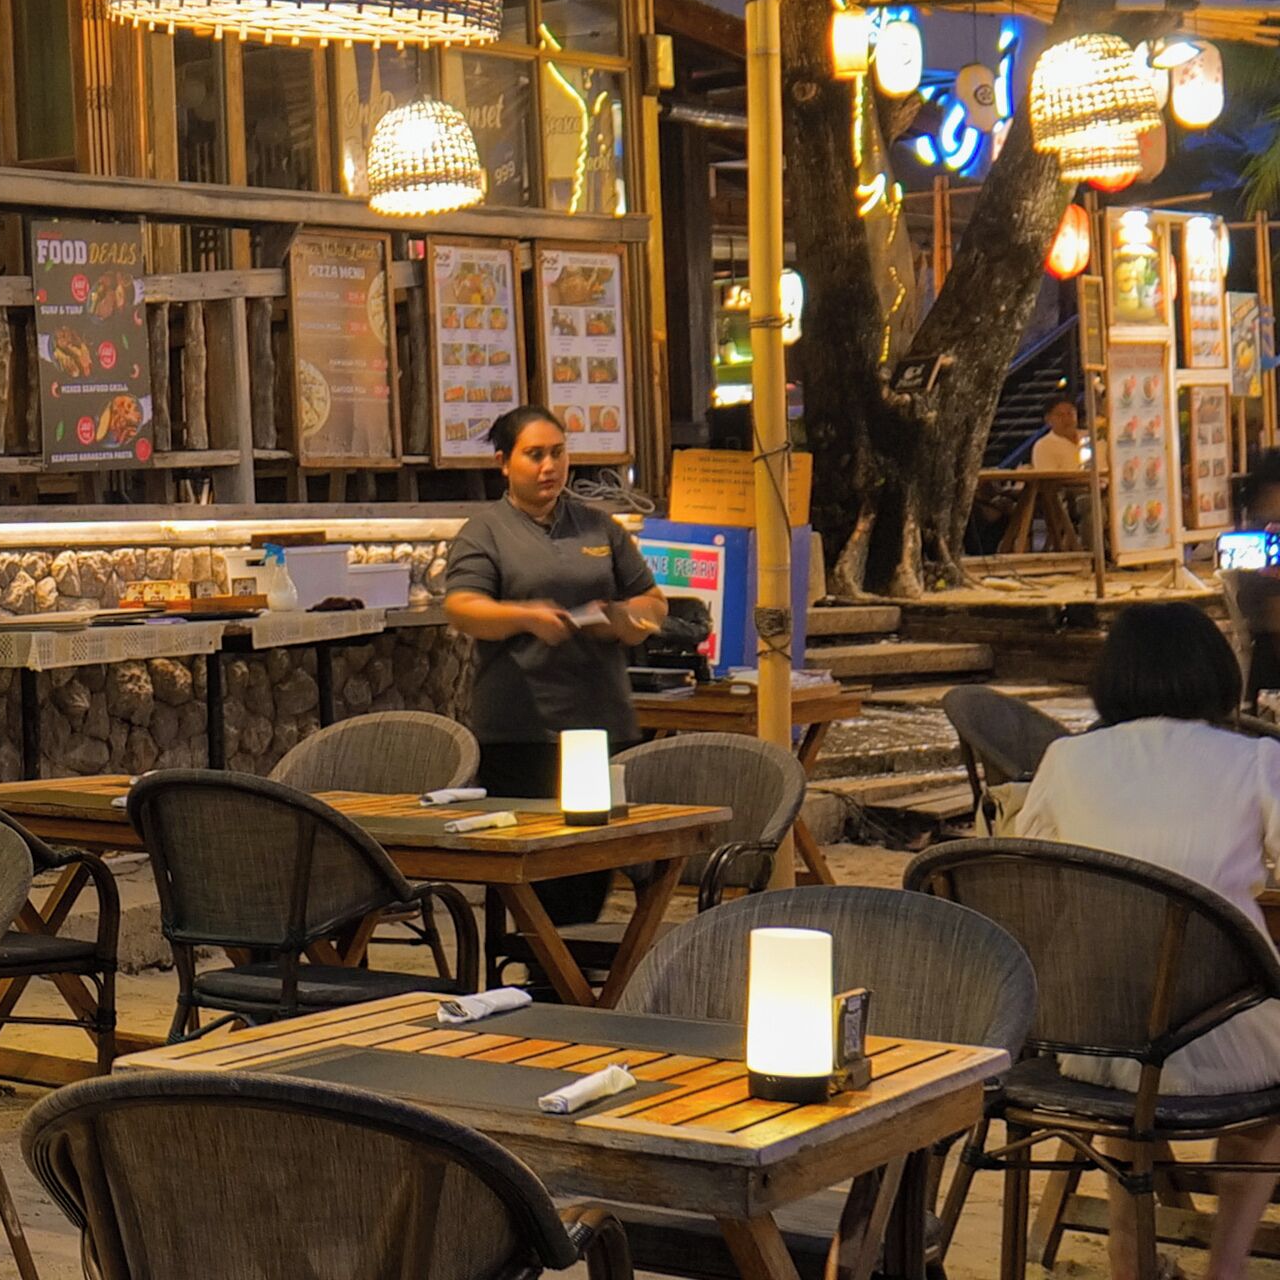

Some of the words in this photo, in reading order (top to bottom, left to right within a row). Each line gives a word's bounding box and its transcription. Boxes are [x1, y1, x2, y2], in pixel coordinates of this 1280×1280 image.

[37, 240, 87, 264] FOOD
[88, 242, 137, 265] DEALS
[308, 265, 339, 278] PIZZA
[674, 557, 716, 577] FERRY
